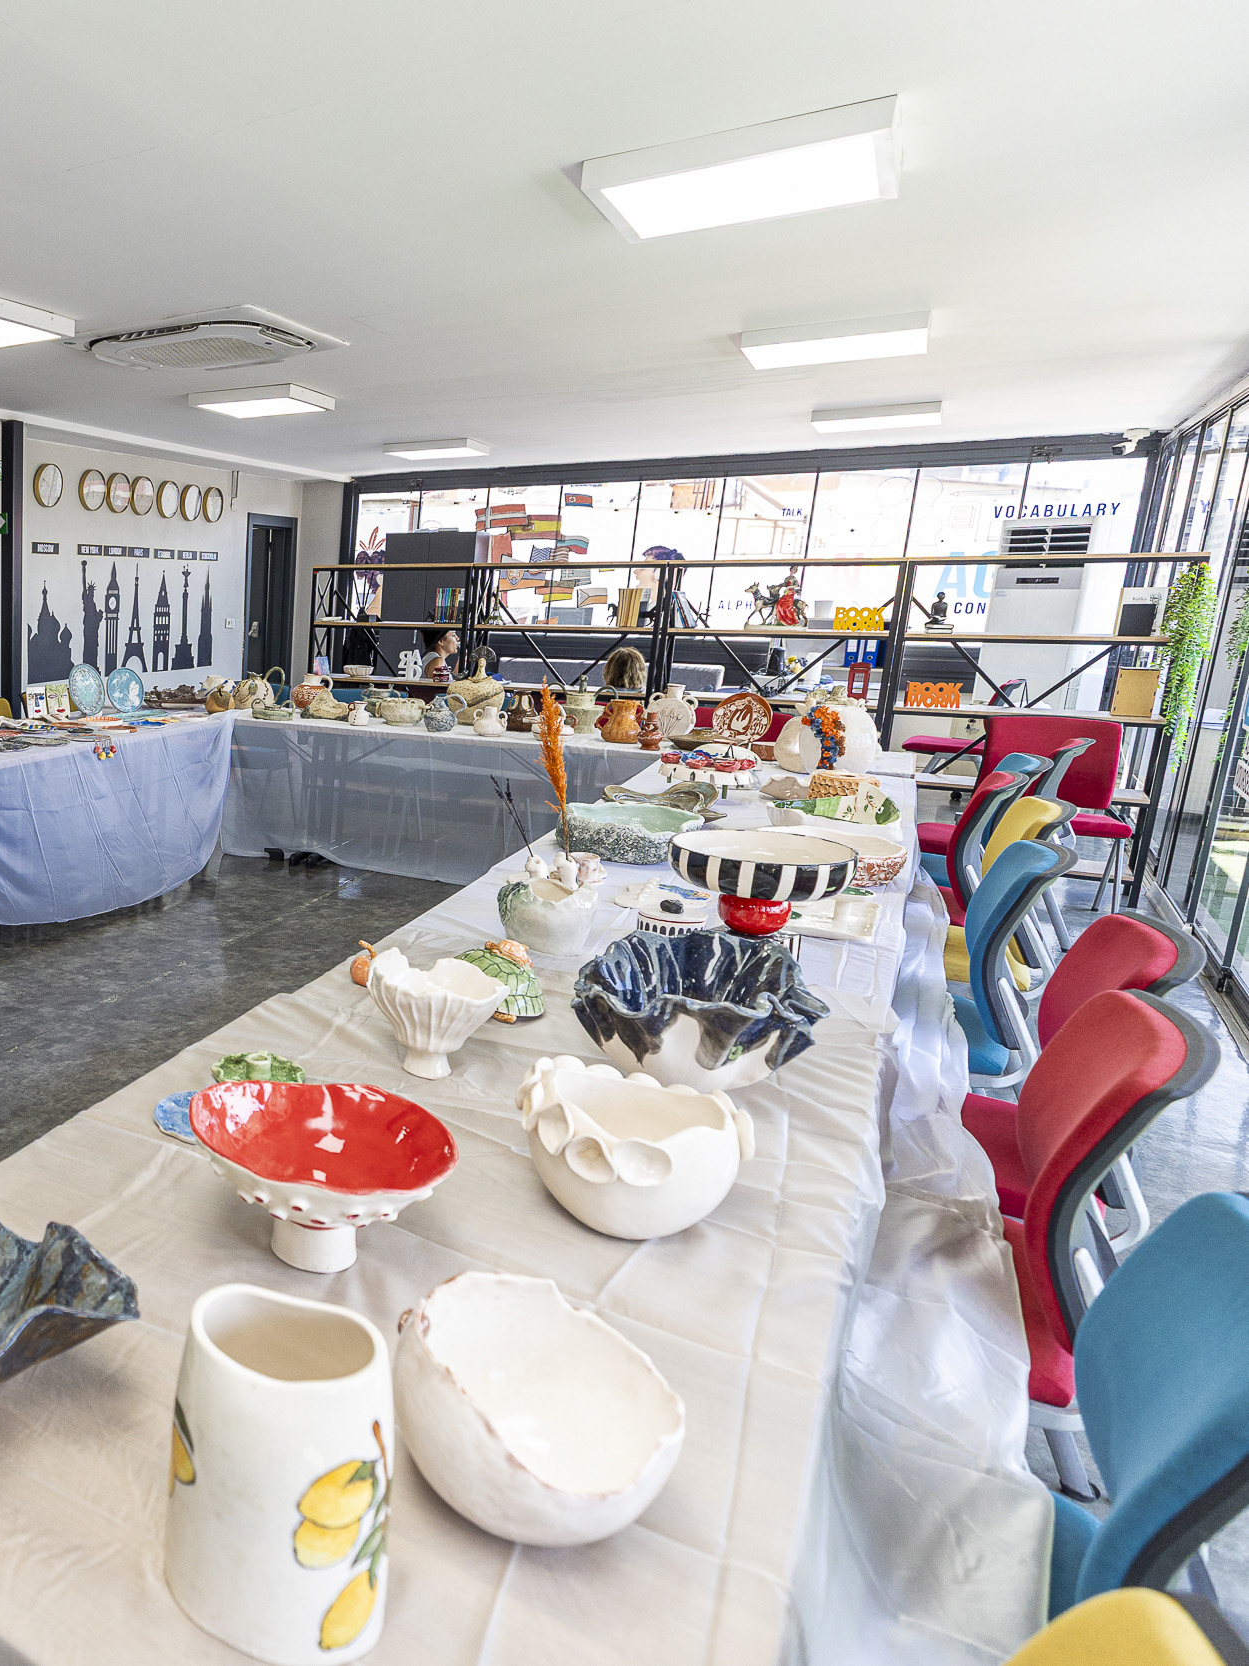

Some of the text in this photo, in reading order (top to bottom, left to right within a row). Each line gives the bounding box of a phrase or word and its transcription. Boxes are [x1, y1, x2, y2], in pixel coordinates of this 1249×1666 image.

[782, 508, 803, 516] TALK
[994, 502, 1121, 518] VOCABULARY
[836, 607, 886, 619] BOOK
[953, 601, 987, 614] CON
[833, 617, 884, 632] WORM
[908, 682, 963, 695] BOOK
[906, 693, 961, 709] WORM
